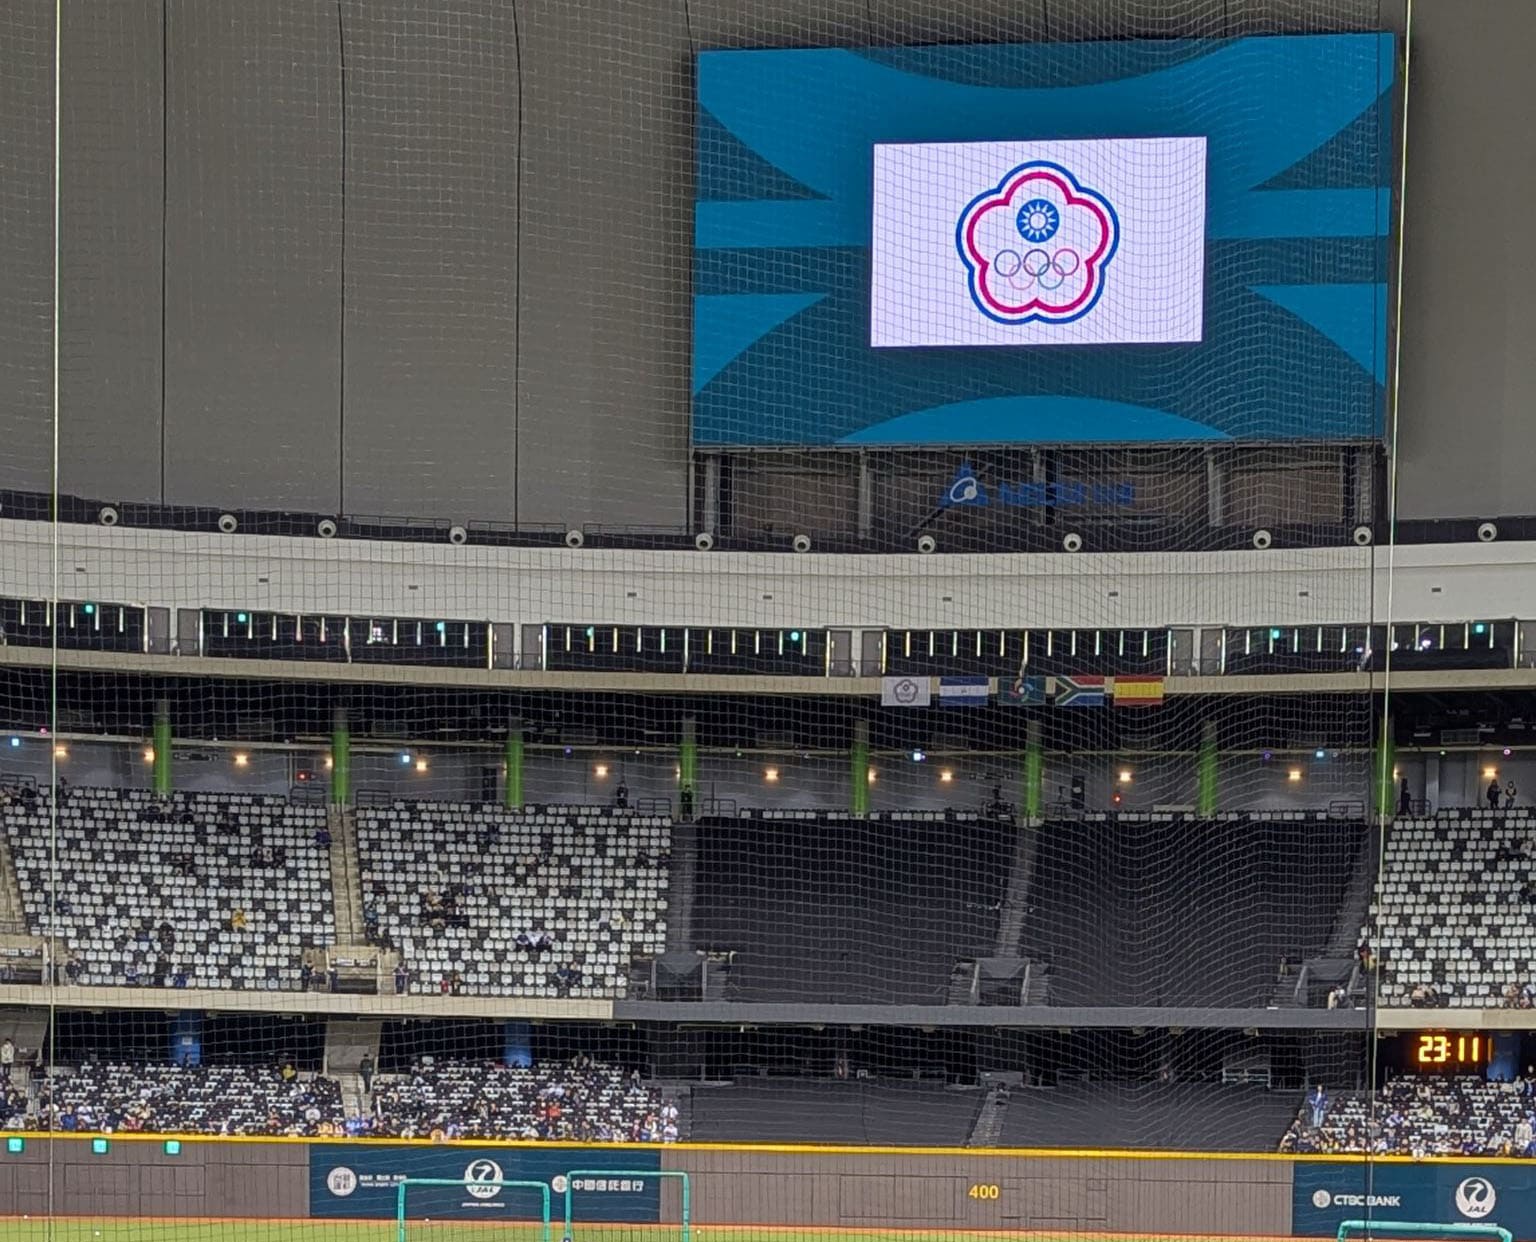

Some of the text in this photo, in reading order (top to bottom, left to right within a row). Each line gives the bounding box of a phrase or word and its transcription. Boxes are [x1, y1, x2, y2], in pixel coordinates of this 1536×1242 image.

[1418, 1036, 1479, 1062] 23:11
[968, 1184, 999, 1199] 400
[1333, 1194, 1401, 1207] CTBC BANK
